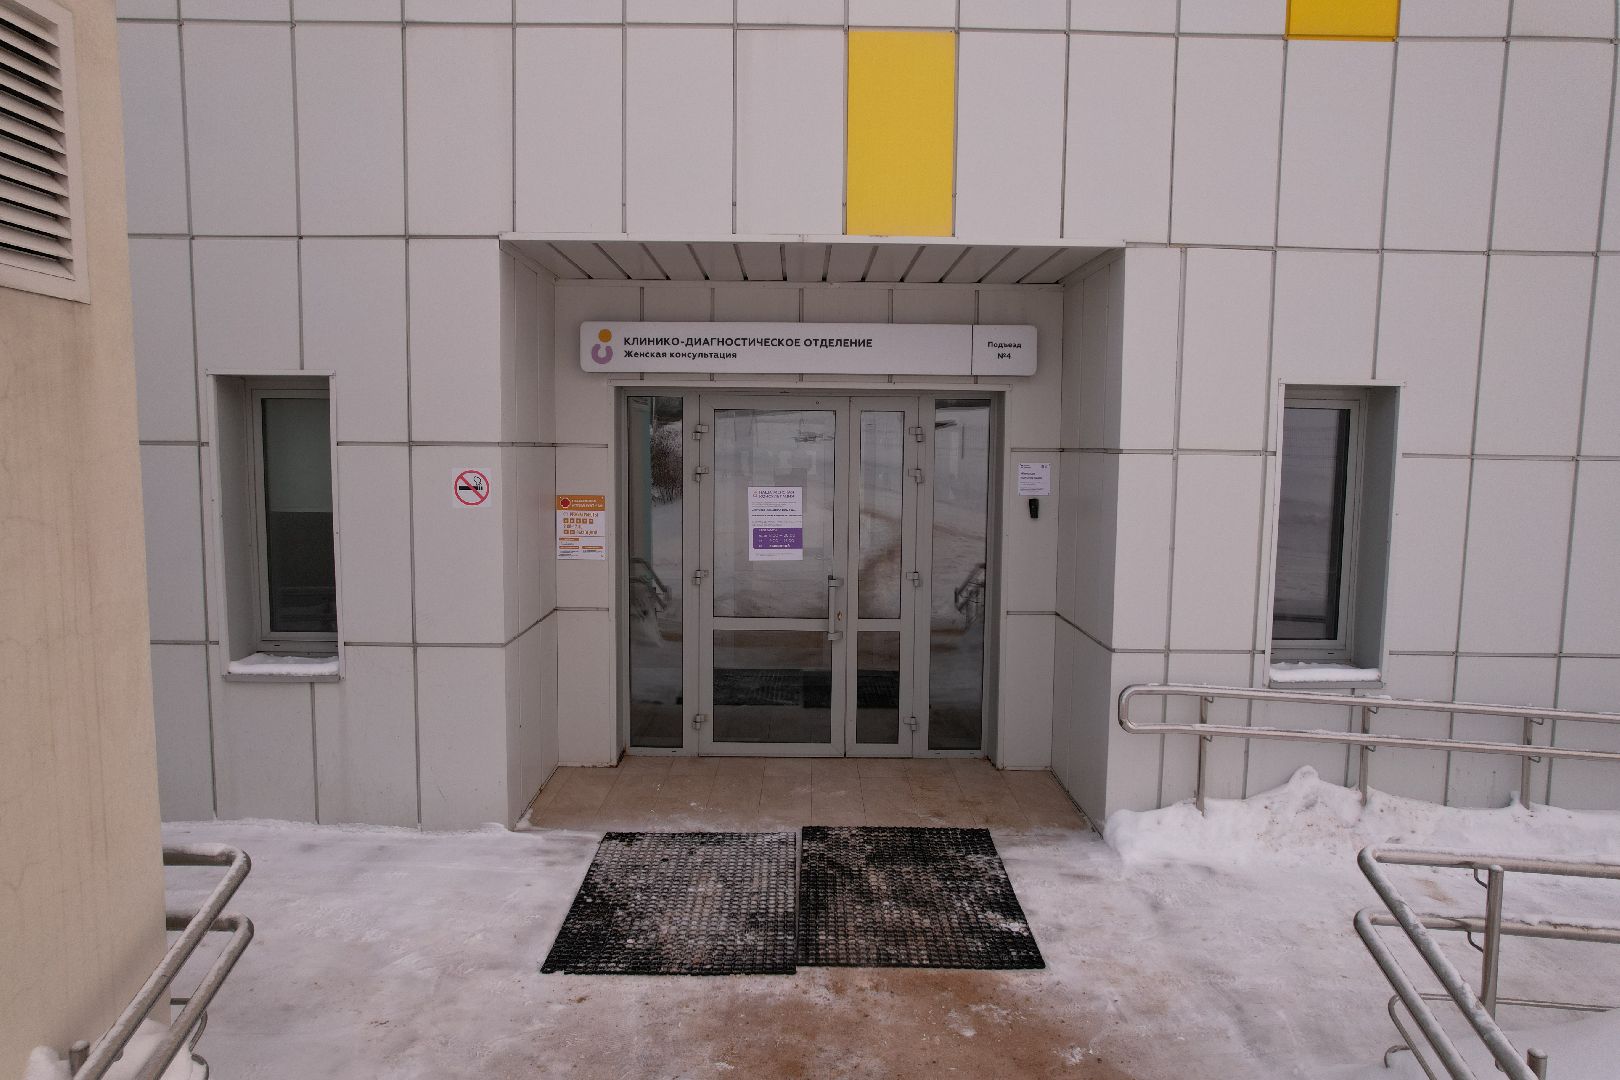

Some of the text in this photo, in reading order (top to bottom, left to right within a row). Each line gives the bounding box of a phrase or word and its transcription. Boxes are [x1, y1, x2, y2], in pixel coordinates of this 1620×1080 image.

[623, 337, 873, 349] КЛИНИКО-ДИАГНОСТИЧЕСКОЕ ОТДЕЛЕНИЕ
[987, 341, 1022, 349] Подъезд
[624, 350, 737, 360] Женская консультация
